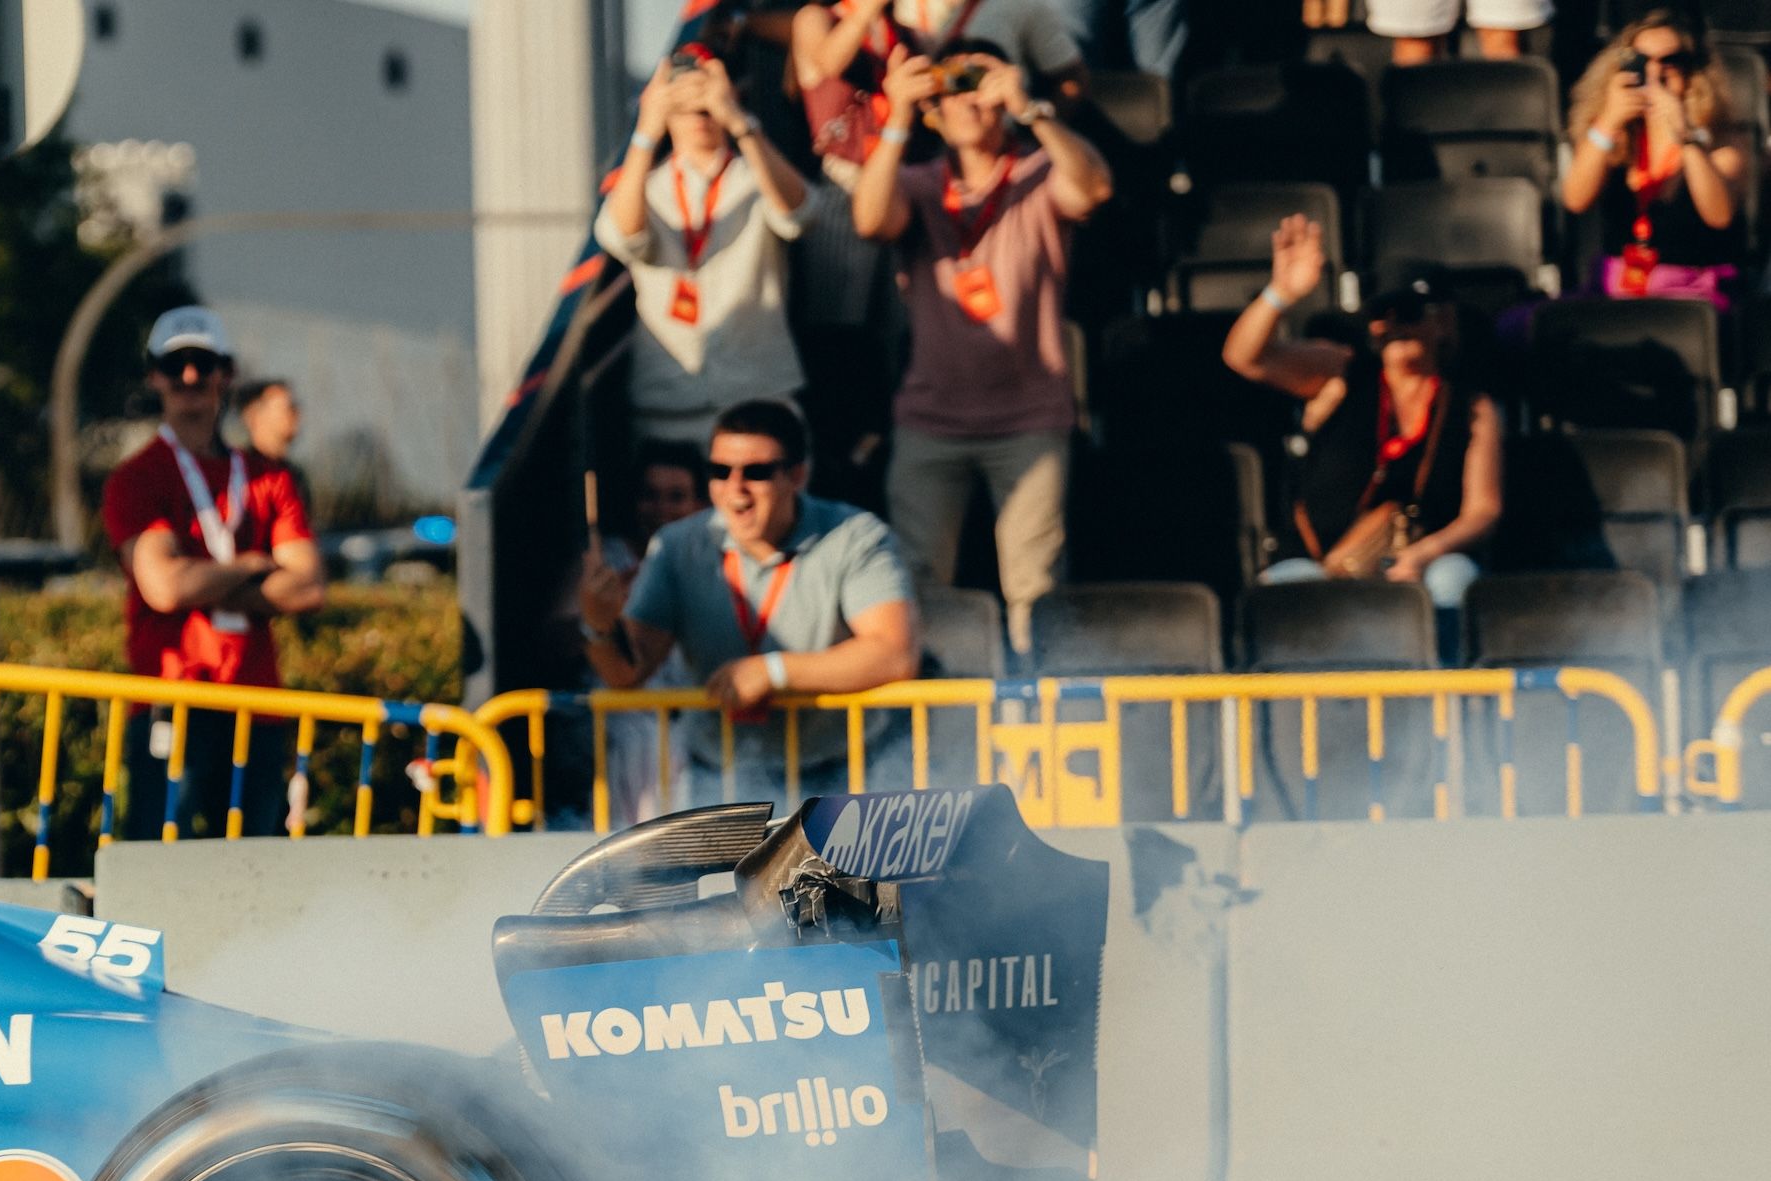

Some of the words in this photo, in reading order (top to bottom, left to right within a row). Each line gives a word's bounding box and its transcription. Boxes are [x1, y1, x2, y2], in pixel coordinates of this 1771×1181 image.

[36, 914, 162, 1000] 55
[923, 953, 1059, 1014] CAPITAL
[540, 981, 871, 1059] KOMATSU
